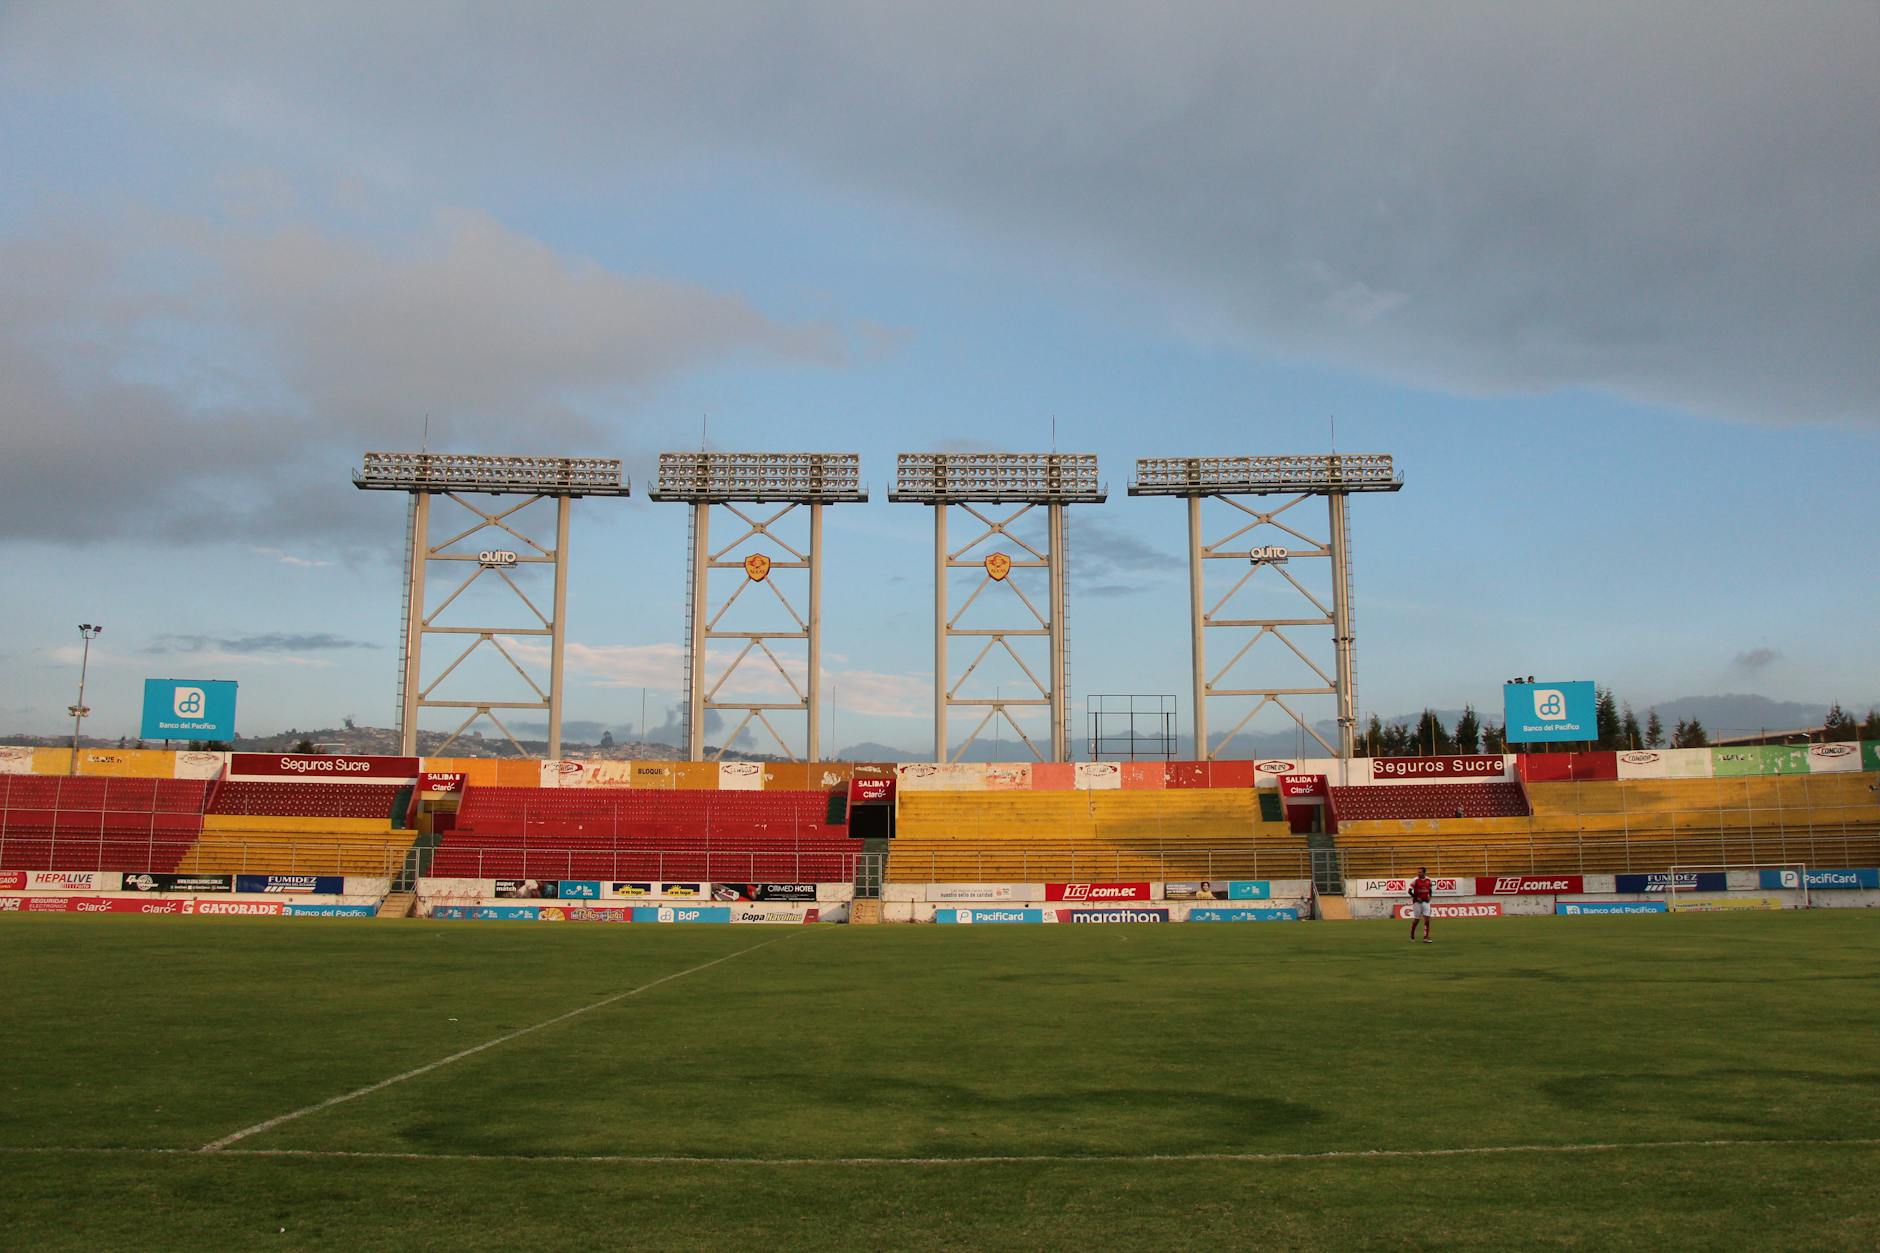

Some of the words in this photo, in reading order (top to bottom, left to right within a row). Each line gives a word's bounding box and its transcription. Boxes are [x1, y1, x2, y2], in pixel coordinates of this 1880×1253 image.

[479, 549, 516, 562] QUITO
[1250, 545, 1288, 559] QUITO
[280, 757, 333, 773] Seguros
[335, 758, 370, 772] Sucre
[1373, 760, 1445, 775] Seguros
[1452, 759, 1504, 772] Sucre
[427, 773, 455, 781] SALIDA
[1285, 776, 1312, 784] SALIDA
[431, 783, 452, 791] Claro
[858, 780, 885, 788] SALIDA
[885, 780, 891, 788] 7
[862, 790, 883, 799] Claro
[1290, 786, 1310, 794] Claro
[35, 873, 94, 883] HEPALIVE
[1803, 873, 1857, 884] PacifiCard
[794, 885, 814, 893] HOTEL
[77, 902, 107, 912] Claro
[141, 904, 171, 913] Claro
[199, 903, 278, 915] GATORADE
[1583, 907, 1609, 915] Banco
[1610, 906, 1624, 914] del
[678, 911, 700, 921] BdP
[741, 912, 765, 922] Copa
[976, 912, 1024, 921] PacifiCard
[1073, 910, 1161, 923] marathon
